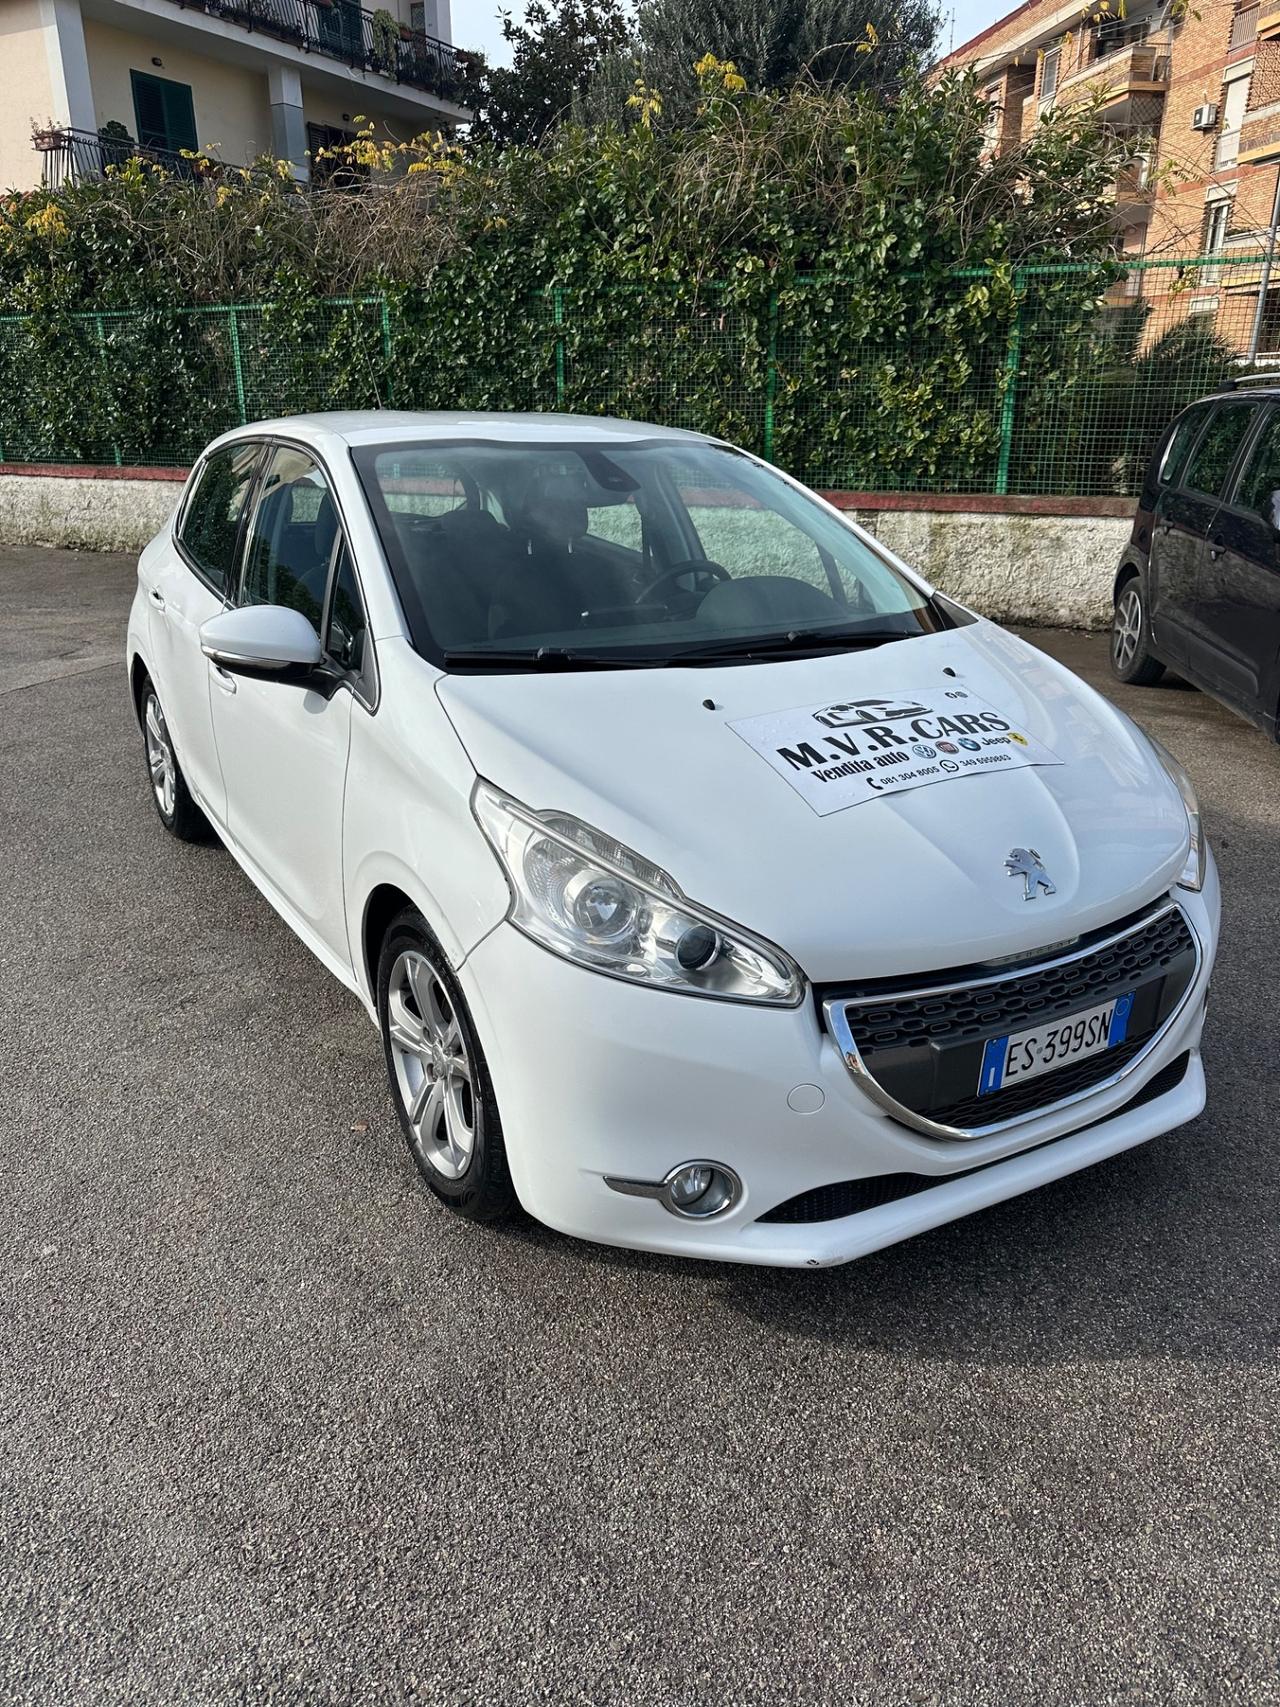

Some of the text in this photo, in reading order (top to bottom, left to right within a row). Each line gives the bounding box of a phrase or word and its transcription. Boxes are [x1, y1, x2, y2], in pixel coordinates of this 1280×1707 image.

[981, 737, 1011, 746] Jeep
[811, 751, 910, 783] Vendita auto
[880, 766, 940, 785] 081 304 8005
